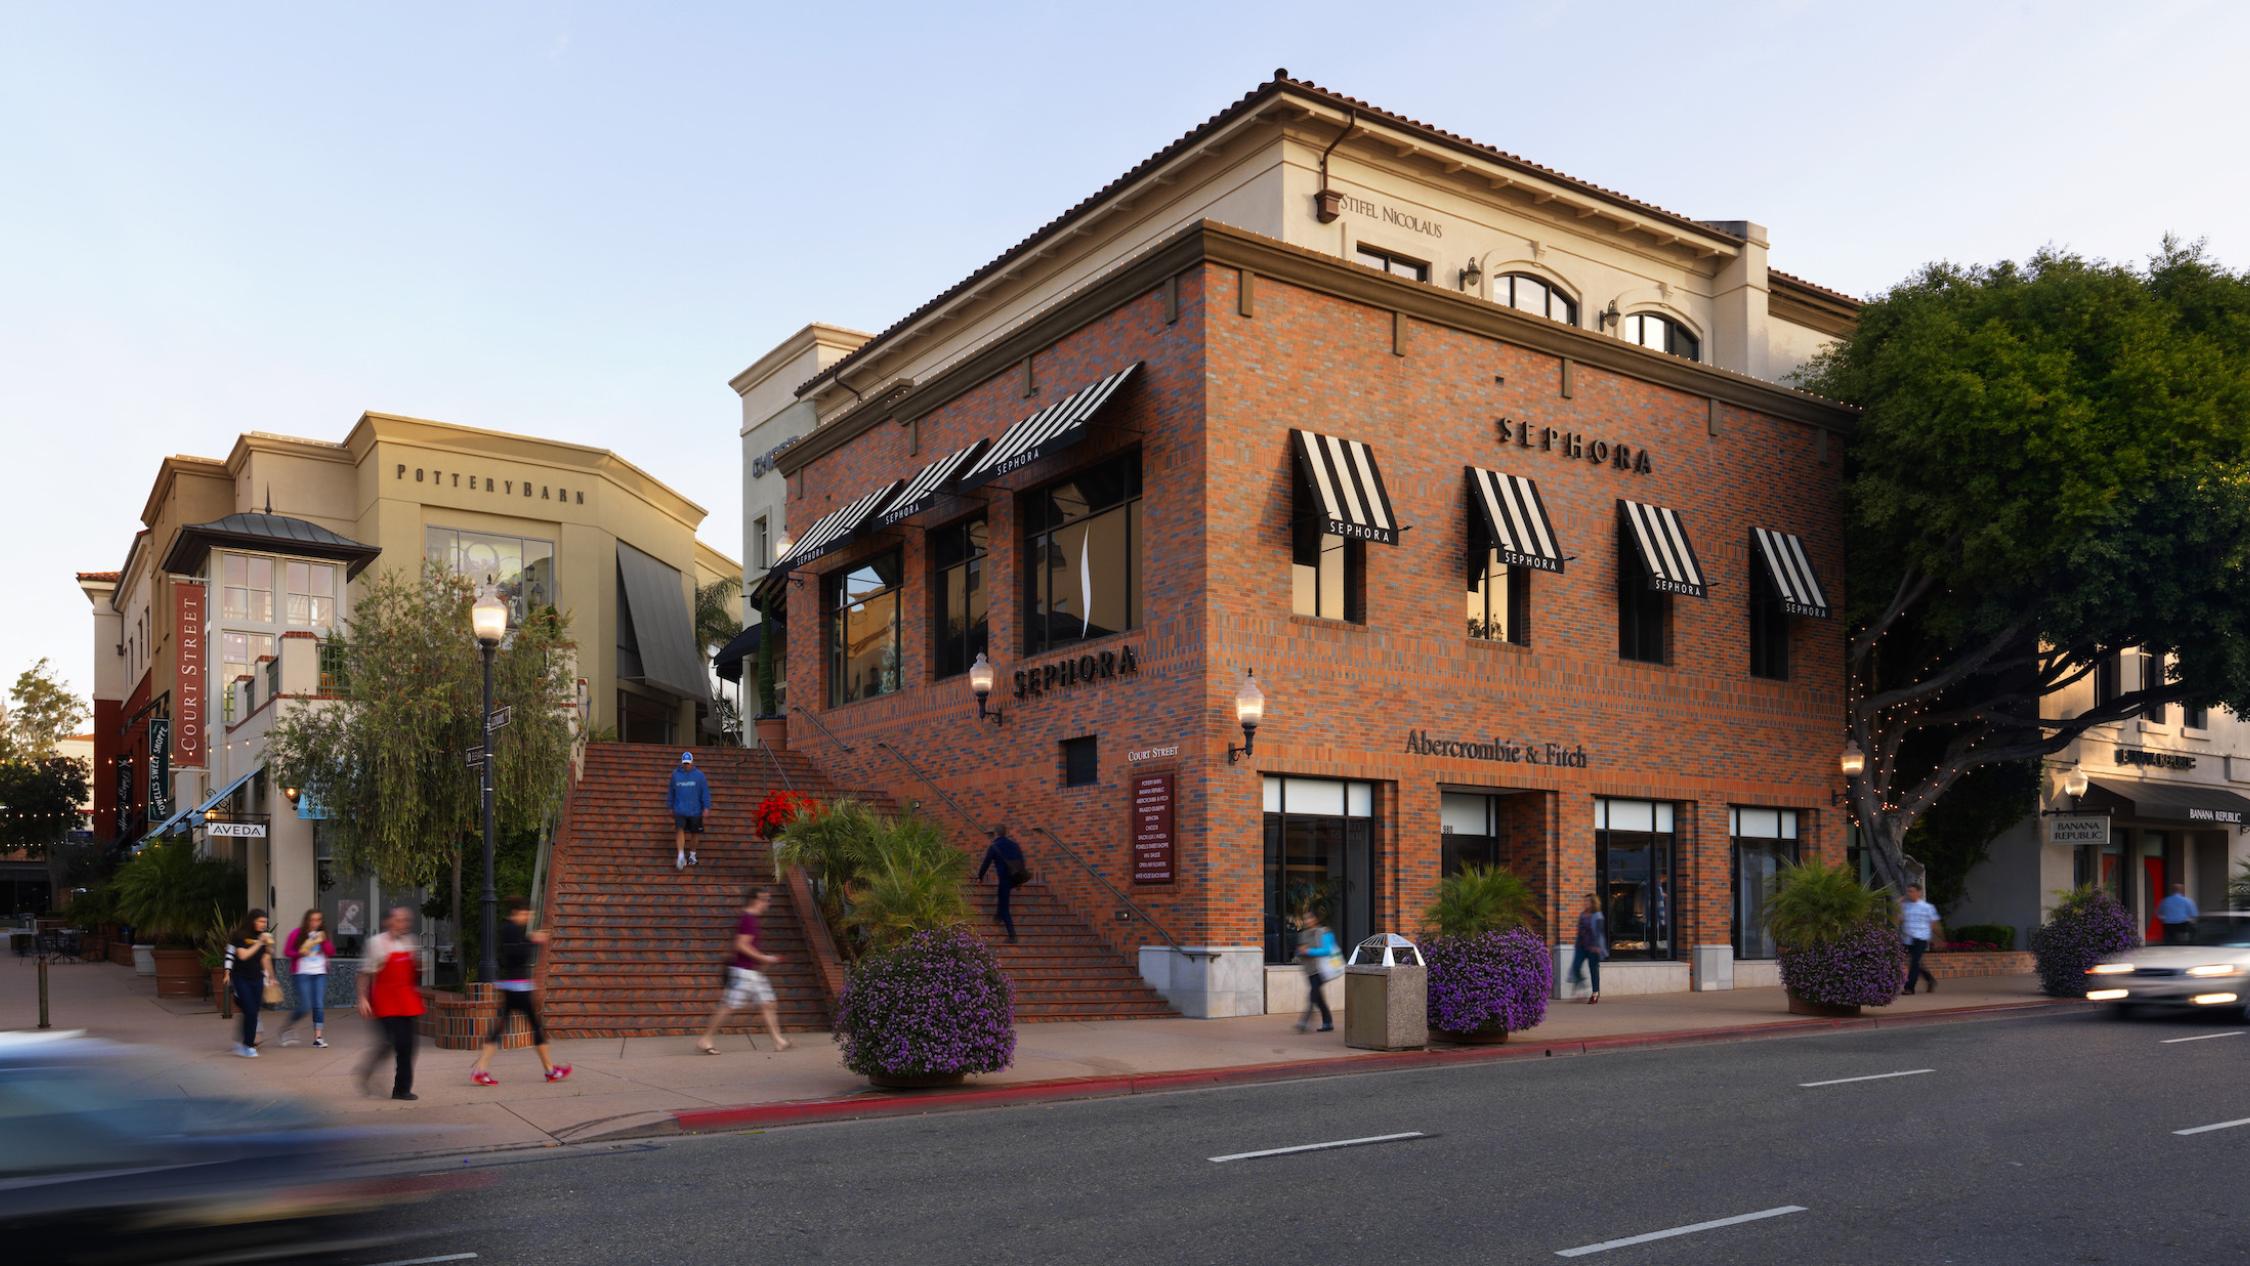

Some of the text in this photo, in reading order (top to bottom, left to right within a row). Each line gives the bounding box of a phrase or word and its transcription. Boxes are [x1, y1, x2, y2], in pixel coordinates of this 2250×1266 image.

[1341, 193, 1442, 238] STIFEL NICOLAUS
[1498, 418, 1652, 474] SEPHORA
[997, 448, 1039, 476] SEPHORA
[885, 503, 919, 525] SEPHORA
[1330, 522, 1390, 542] SEPHORA
[796, 547, 824, 566] SEPHORA
[1504, 552, 1557, 571] SEPHORA
[1655, 579, 1701, 596] SEPHORA
[1785, 602, 1826, 618] SEPHORA
[180, 598, 197, 751] COURT STREET
[1014, 645, 1137, 699] SEPHORA
[1128, 746, 1179, 761] COURT STREET
[1404, 729, 1587, 768] Abercrombie & Fitch
[2189, 808, 2242, 822] BANANA REPUBLIC
[213, 825, 261, 836] AVEDA
[2054, 831, 2103, 840] REPUBLIC
[2057, 822, 2100, 831] BANANA
